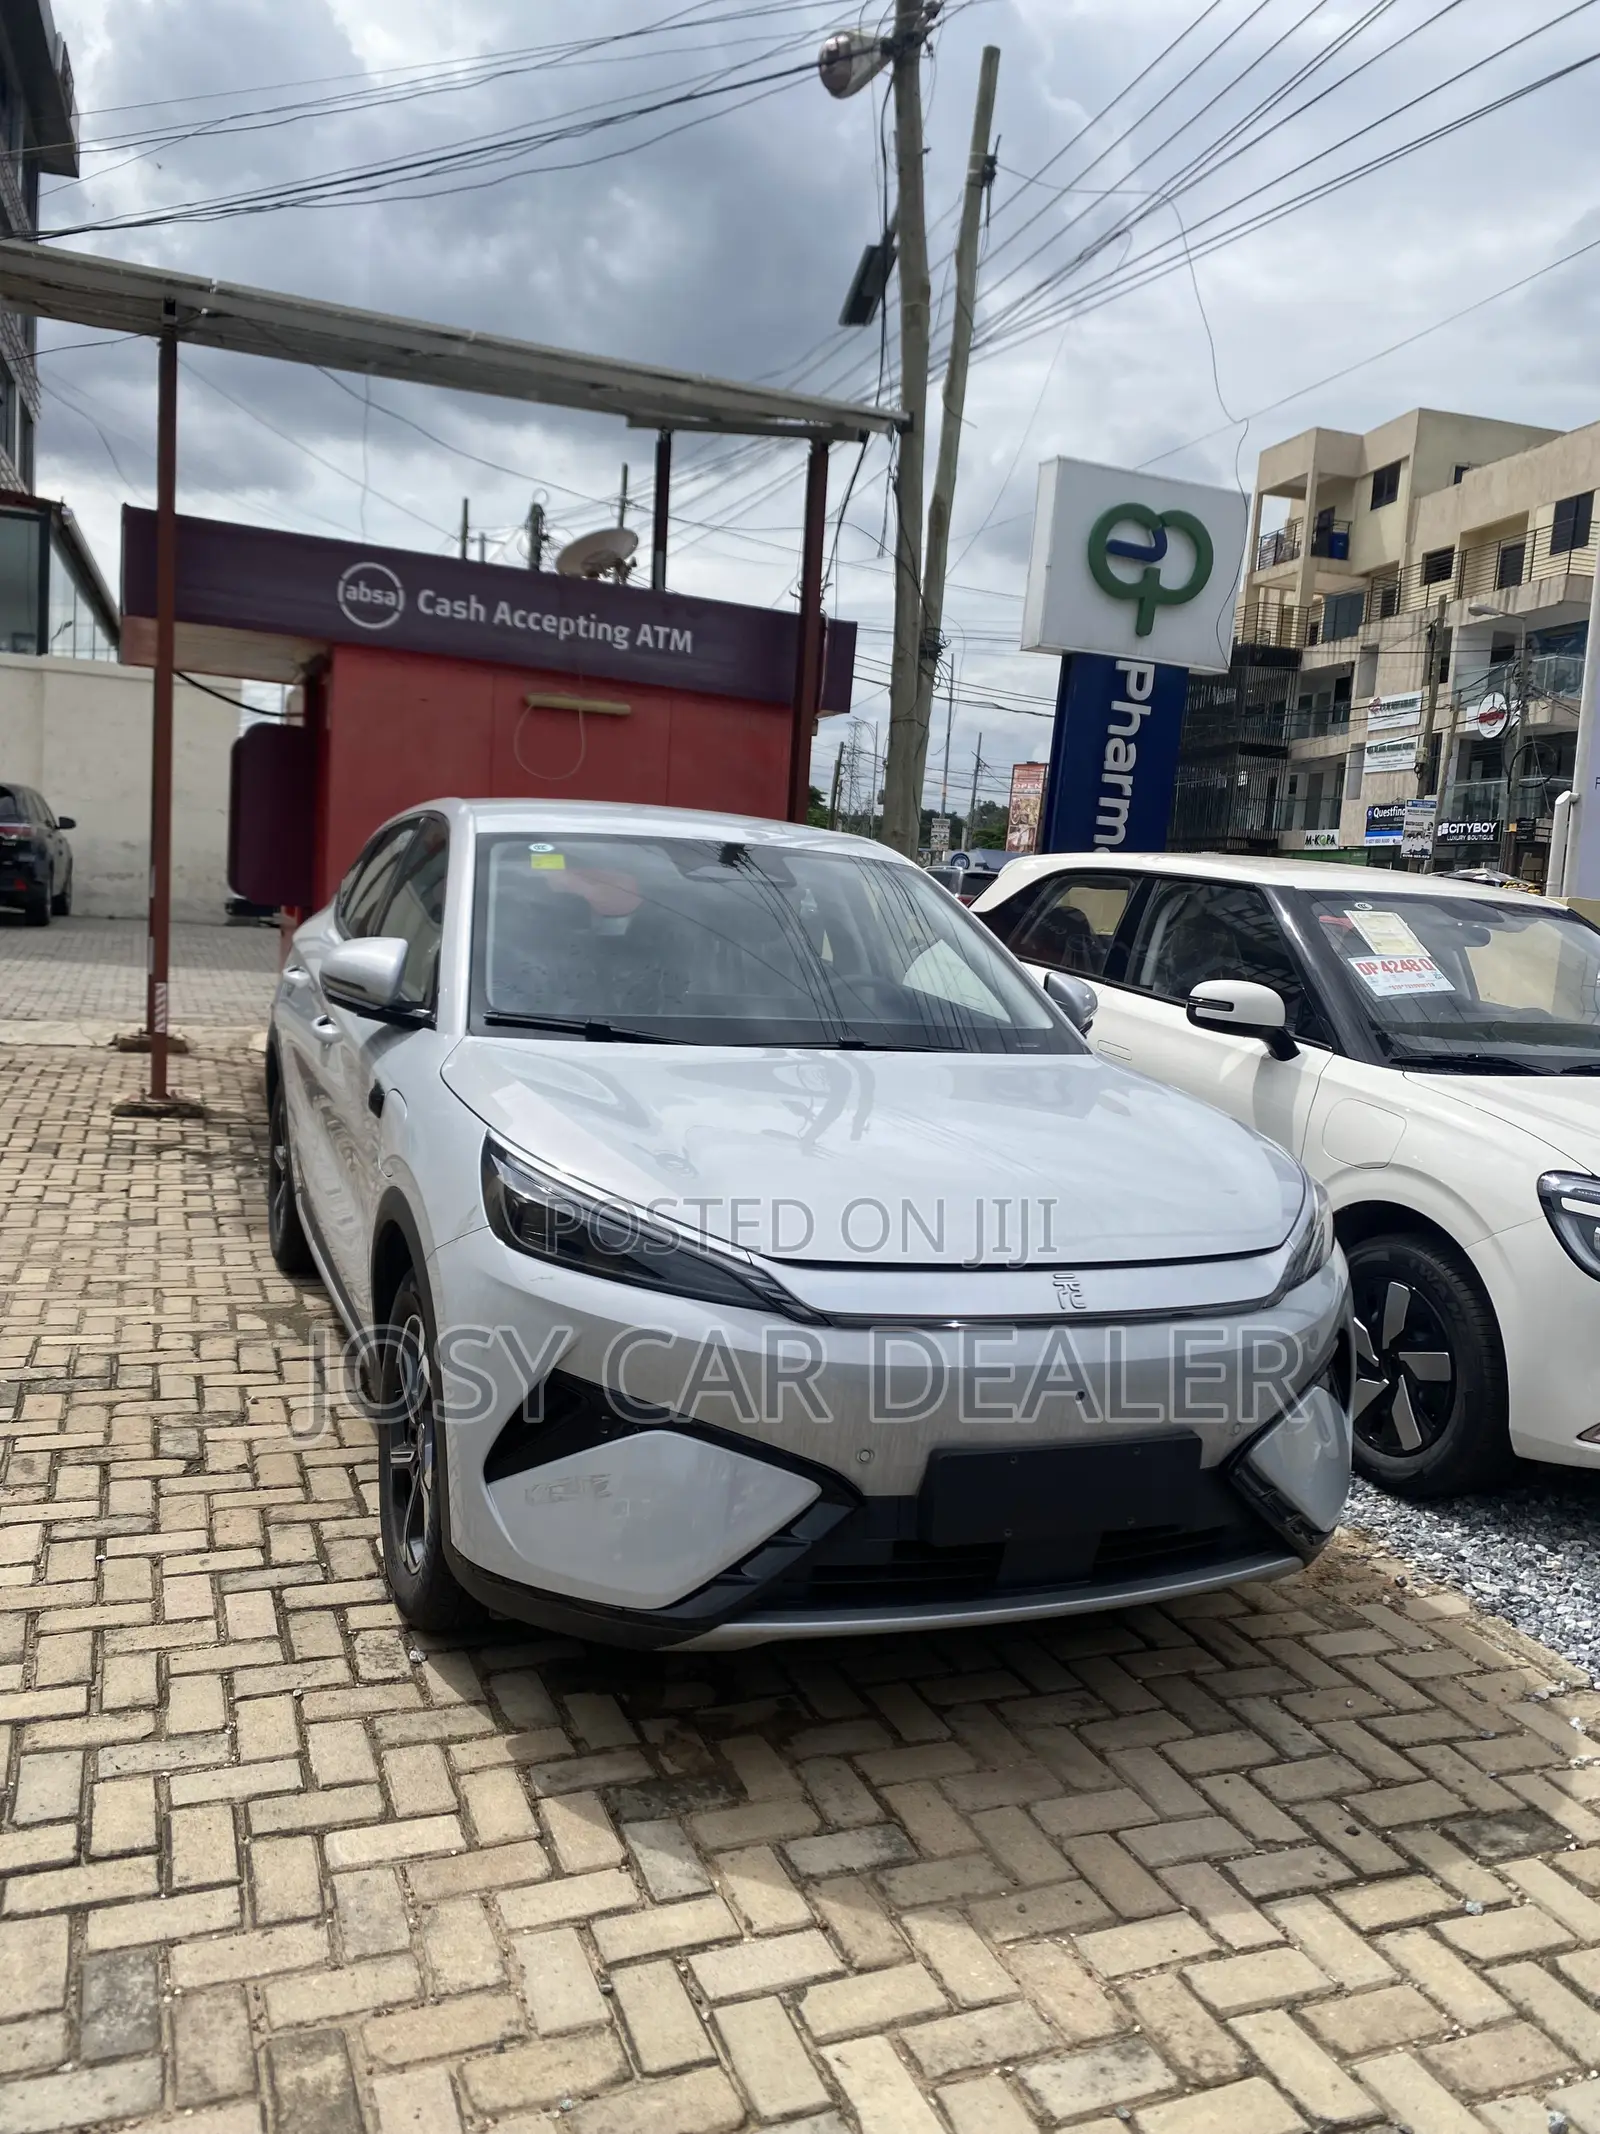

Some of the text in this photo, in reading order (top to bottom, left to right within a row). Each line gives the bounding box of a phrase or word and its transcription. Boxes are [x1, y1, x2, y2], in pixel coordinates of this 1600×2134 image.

[345, 580, 397, 607] absa
[417, 589, 694, 654] Cash Accepting ATM
[1093, 659, 1155, 853] Pharm
[1448, 822, 1497, 833] CITYBOY
[1355, 962, 1378, 975] DP
[1380, 960, 1421, 973] 4248
